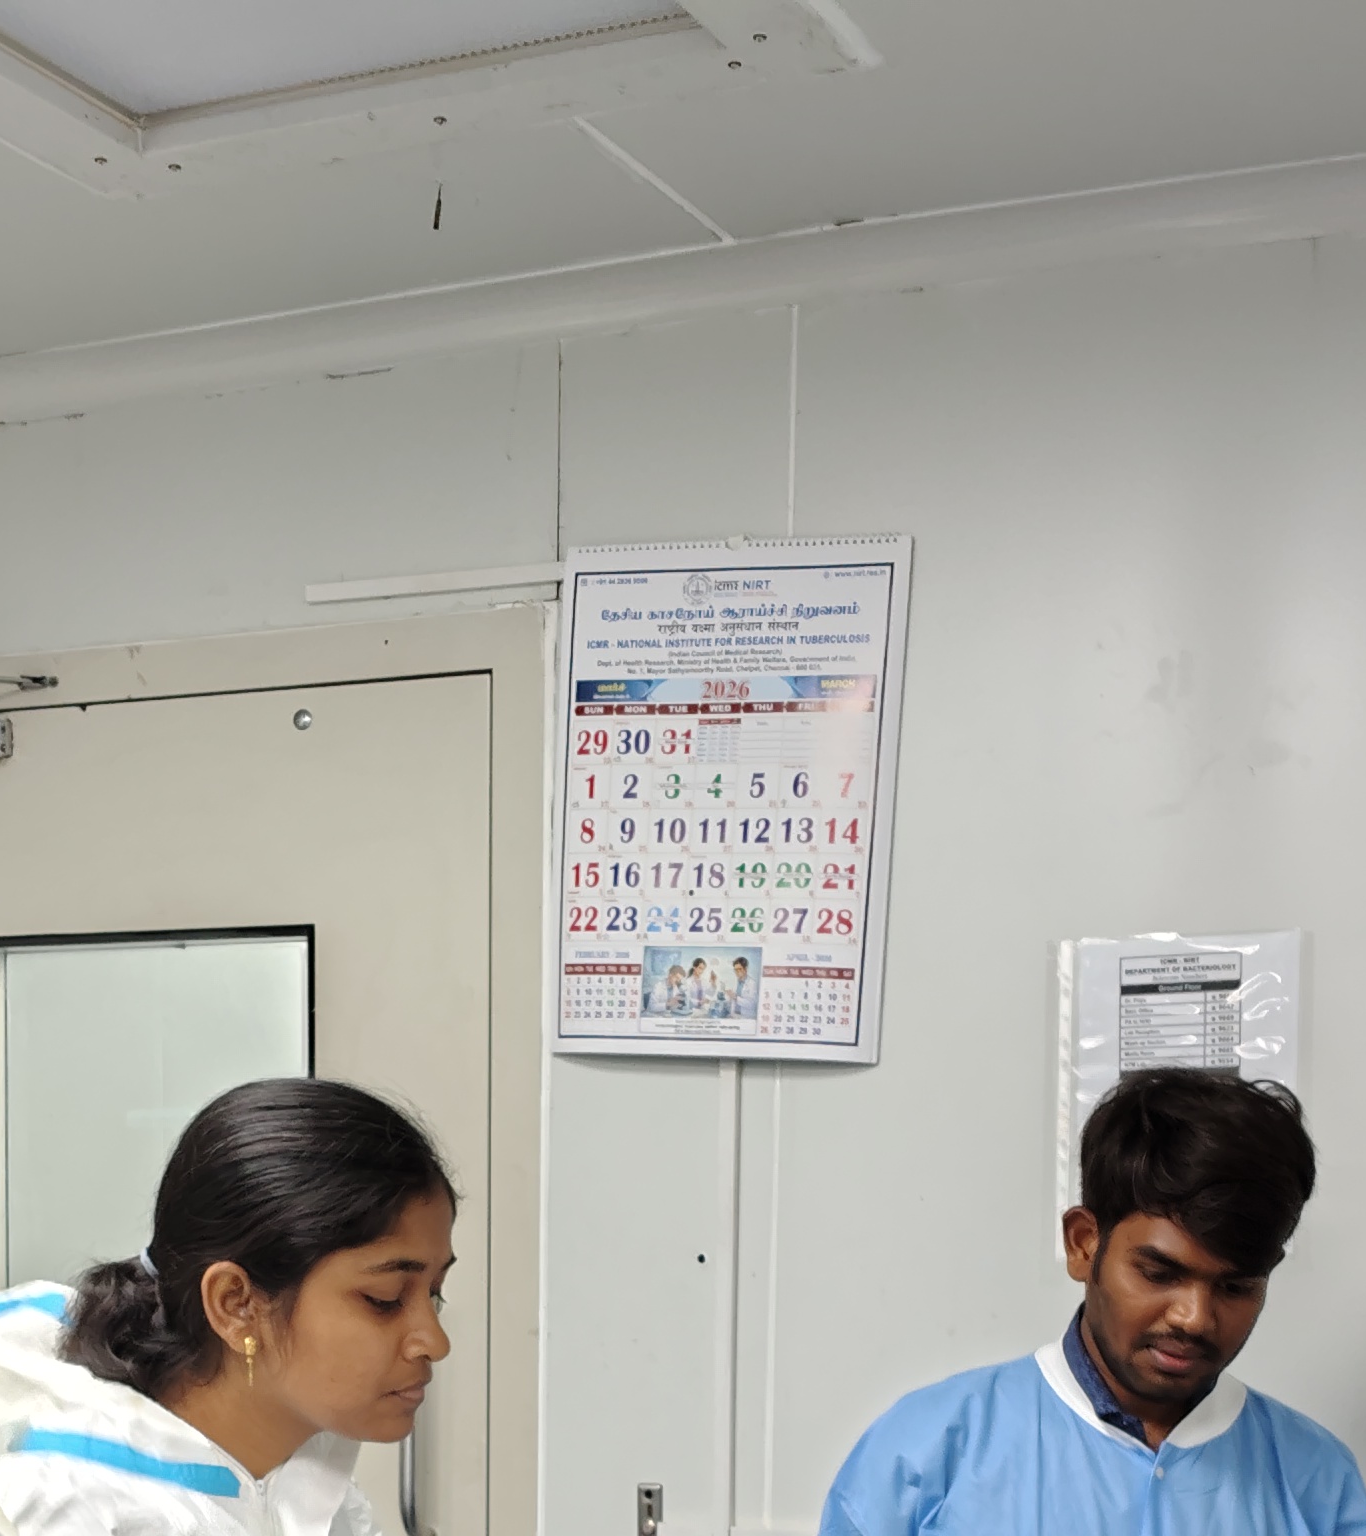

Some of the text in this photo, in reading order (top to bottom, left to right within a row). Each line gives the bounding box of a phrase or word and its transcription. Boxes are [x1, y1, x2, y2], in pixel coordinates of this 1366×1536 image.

[743, 580, 771, 590] NIRT
[601, 602, 860, 621] தேசிய காசநோய் ஆராய்ச்சி நிறுவனம்
[657, 620, 686, 636] राष्ट्रीय
[720, 619, 762, 636] अनुसंधान
[768, 619, 799, 631] संस्थान
[587, 634, 870, 649] ICMR NATIONAL INSTITUTE FOR RESEARCH IN TUBERCULOSIS
[702, 679, 751, 699] 2026
[821, 680, 855, 688] MARCH
[709, 705, 731, 713] WED
[577, 730, 609, 755] 29
[617, 730, 651, 754] 30
[661, 729, 691, 754] 31
[585, 772, 854, 799] 1 2 3 4 5 6 7
[580, 818, 859, 844] 8 9 10 11 12 13 14
[572, 862, 856, 890] 15 16 17 18 19 20 21
[569, 906, 853, 934] 22 23 24 25 26 27 28
[1183, 964, 1235, 972] BACTERIOLOGY
